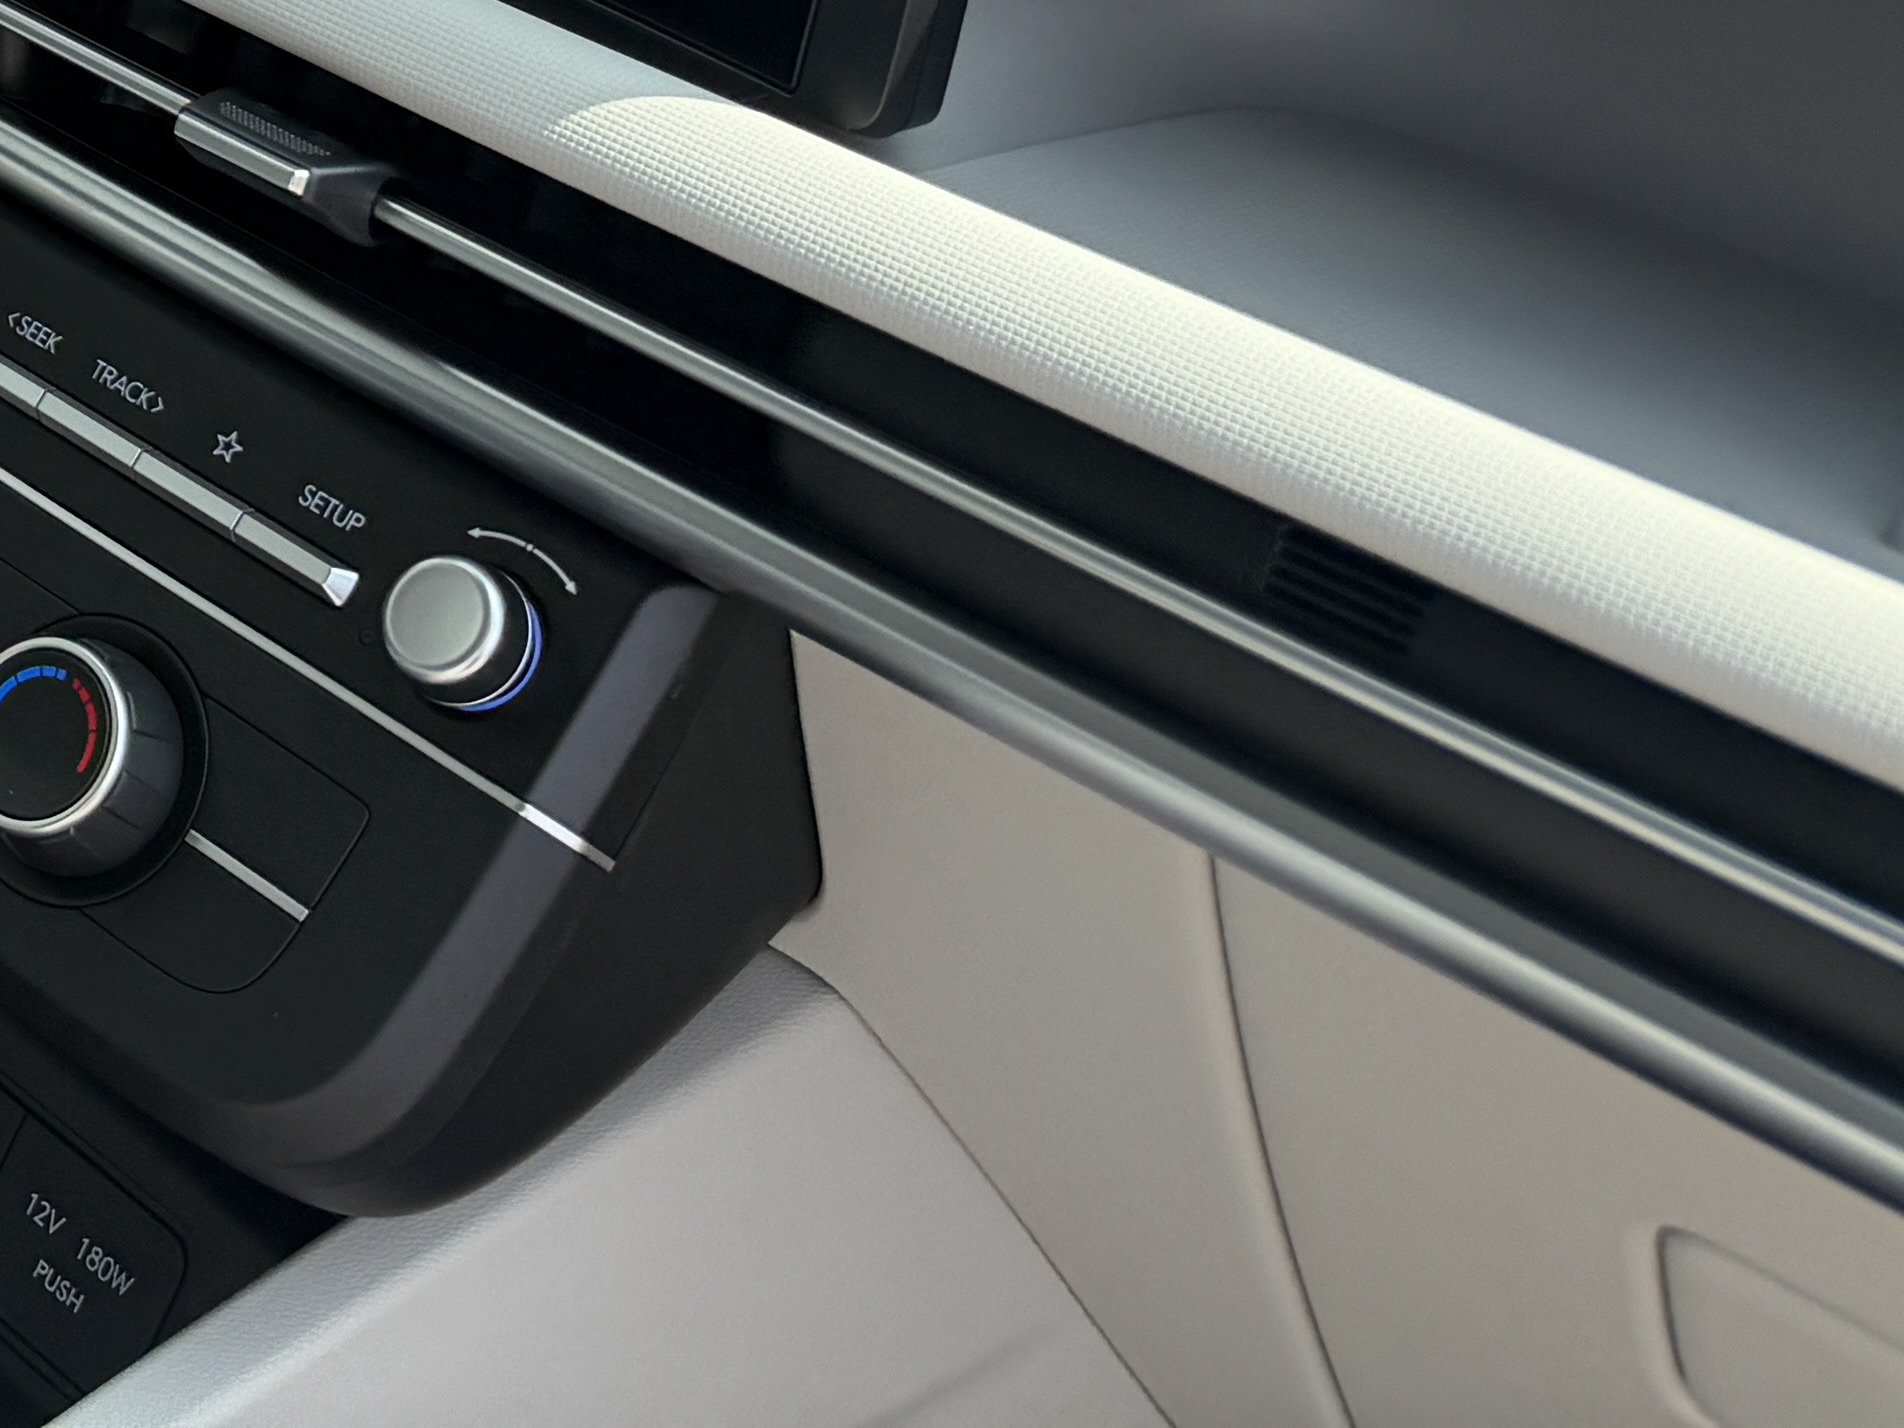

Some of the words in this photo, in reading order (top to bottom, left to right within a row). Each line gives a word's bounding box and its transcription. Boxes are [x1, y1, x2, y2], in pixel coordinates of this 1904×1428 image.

[298, 484, 367, 534] SETUP
[26, 1192, 68, 1235] 12V
[76, 1237, 135, 1296] 180W
[32, 1259, 85, 1314] PUSH
